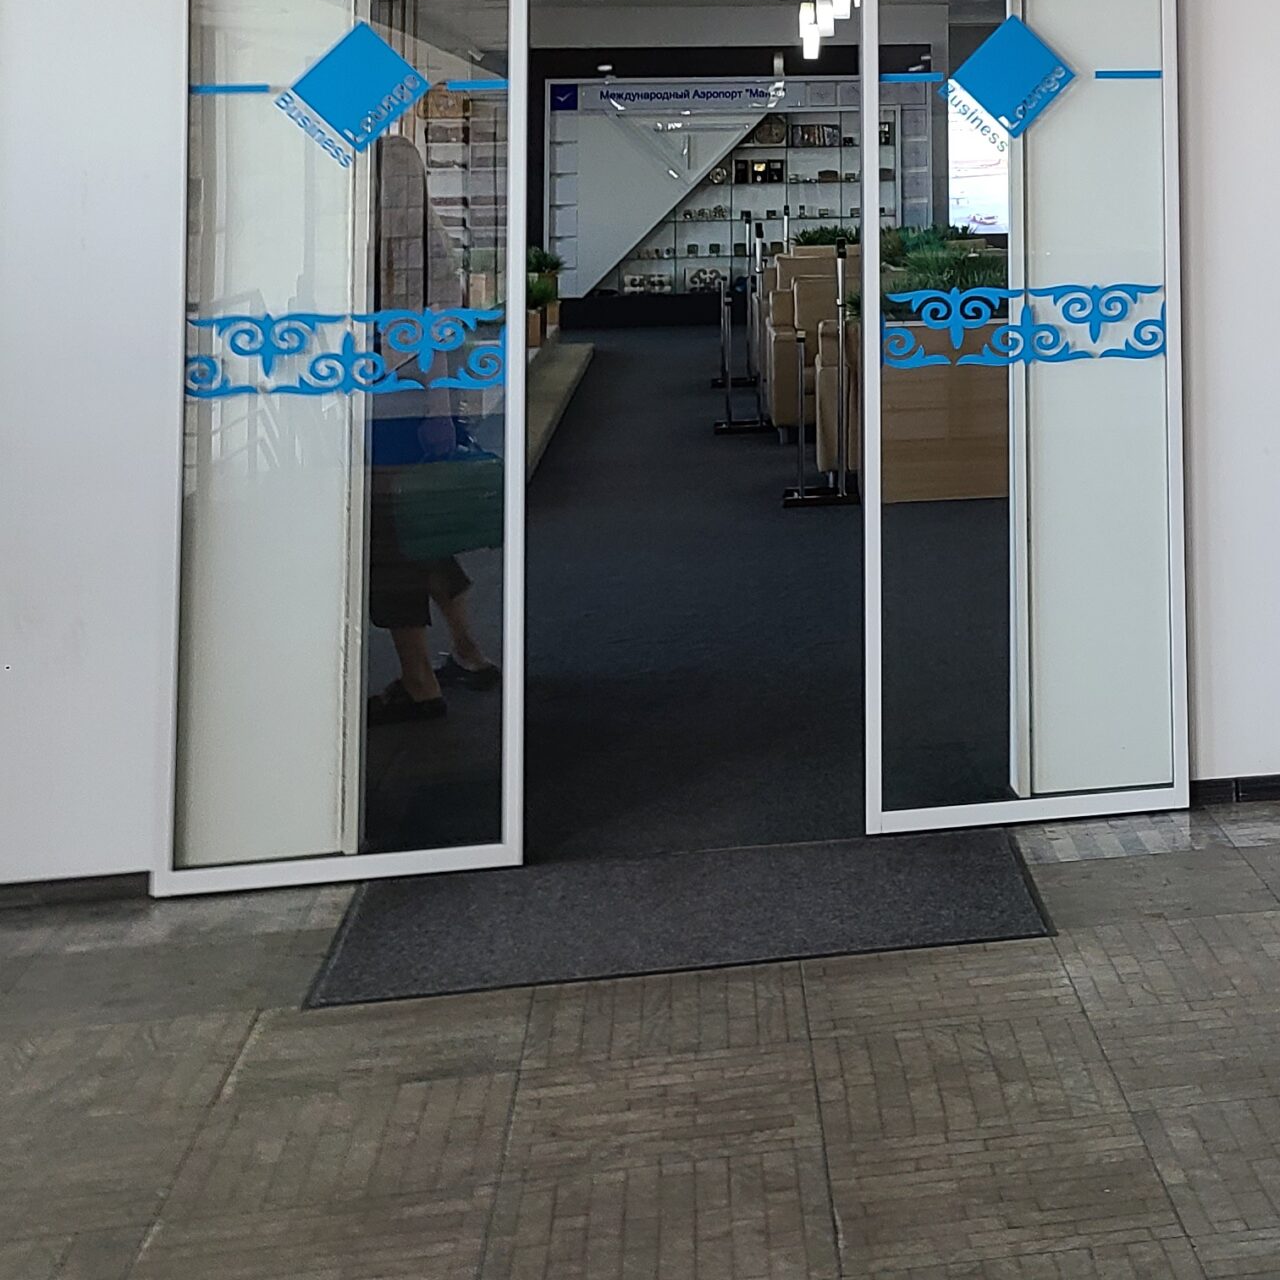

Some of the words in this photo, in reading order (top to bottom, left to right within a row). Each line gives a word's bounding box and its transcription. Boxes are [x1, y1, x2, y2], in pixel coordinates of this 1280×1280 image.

[343, 74, 420, 143] Lounge
[600, 89, 690, 102] Международный
[693, 89, 742, 101] Аэропорт
[998, 66, 1066, 130] Lounge
[274, 91, 353, 169] Business
